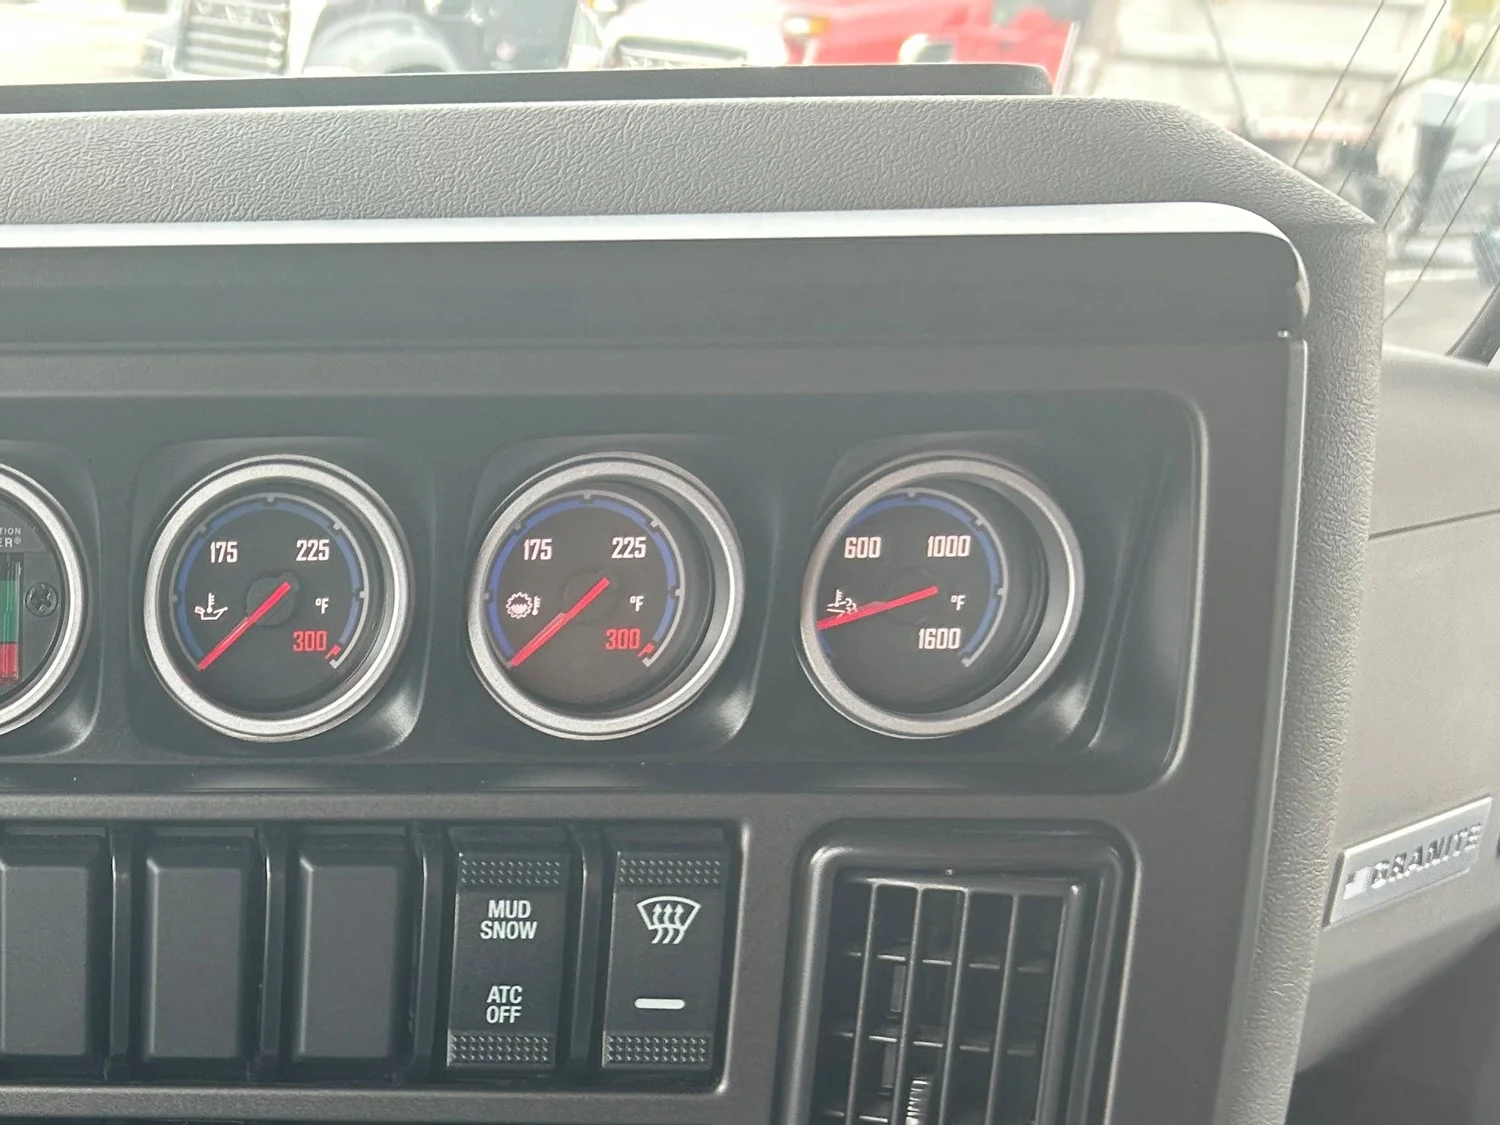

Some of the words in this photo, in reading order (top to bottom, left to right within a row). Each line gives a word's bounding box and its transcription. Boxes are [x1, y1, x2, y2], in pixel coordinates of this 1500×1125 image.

[209, 542, 238, 563] 175
[296, 540, 330, 561] 225
[523, 539, 552, 560] 175
[611, 537, 647, 558] 225
[844, 536, 881, 558] 600
[927, 535, 971, 557] 1000
[292, 631, 328, 651] 300
[605, 628, 641, 650] 300
[918, 628, 961, 649] 1600
[488, 900, 531, 918] MUD
[480, 921, 537, 939] SNOW
[486, 985, 522, 1004] ATC
[486, 1005, 522, 1023] OFF
